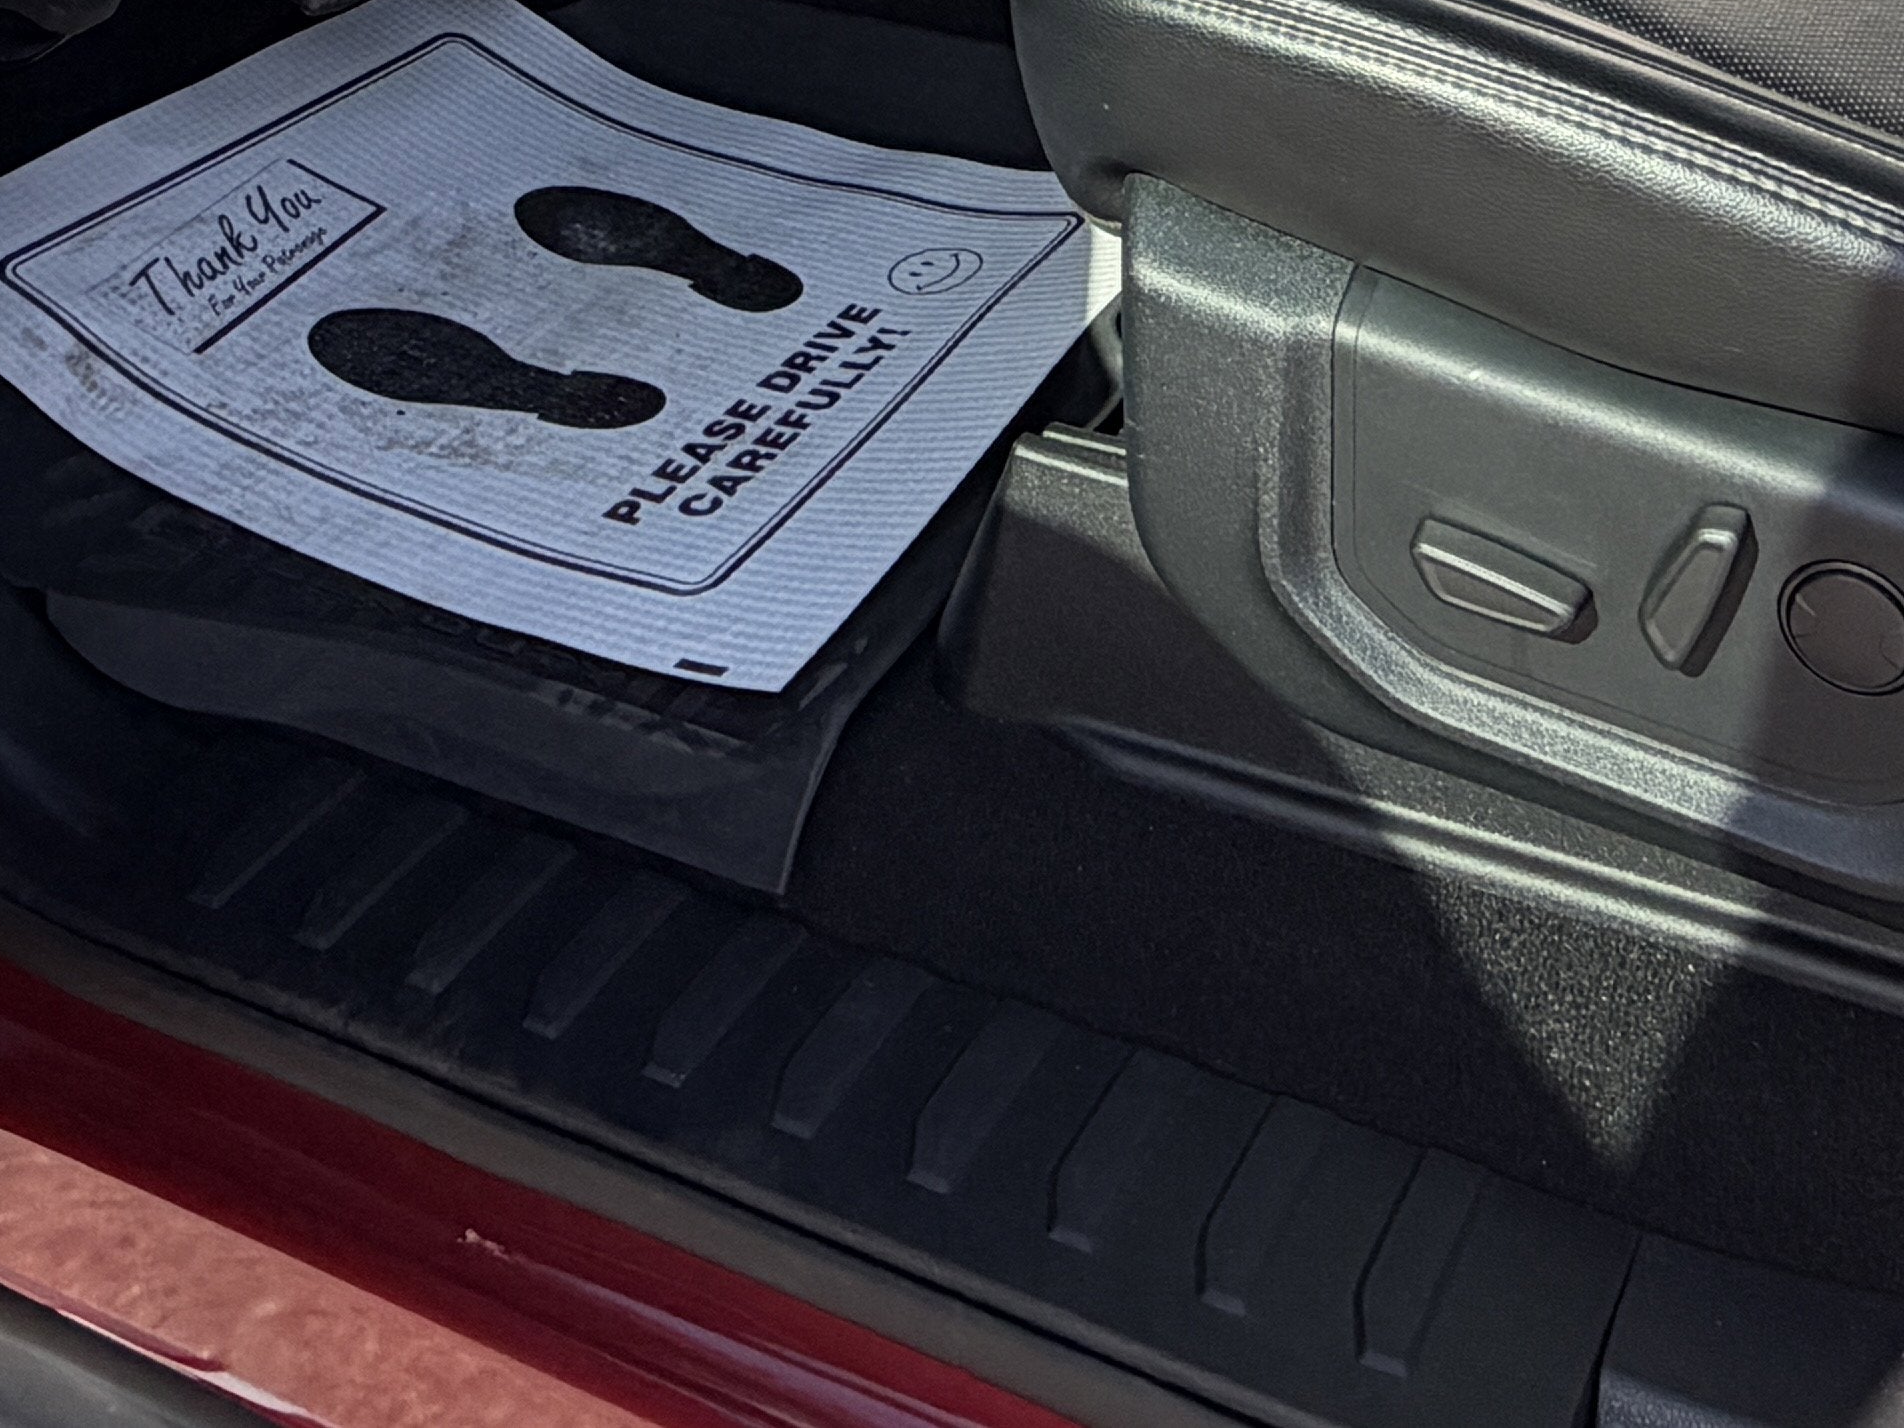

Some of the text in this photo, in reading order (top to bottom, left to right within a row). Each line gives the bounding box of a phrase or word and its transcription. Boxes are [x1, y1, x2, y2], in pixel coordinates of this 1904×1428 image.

[128, 184, 322, 317] Thank You
[207, 294, 237, 317] For
[232, 271, 266, 297] Your
[600, 302, 883, 526] PLEASE DRIVE
[677, 326, 912, 517] CAREFULLY!
